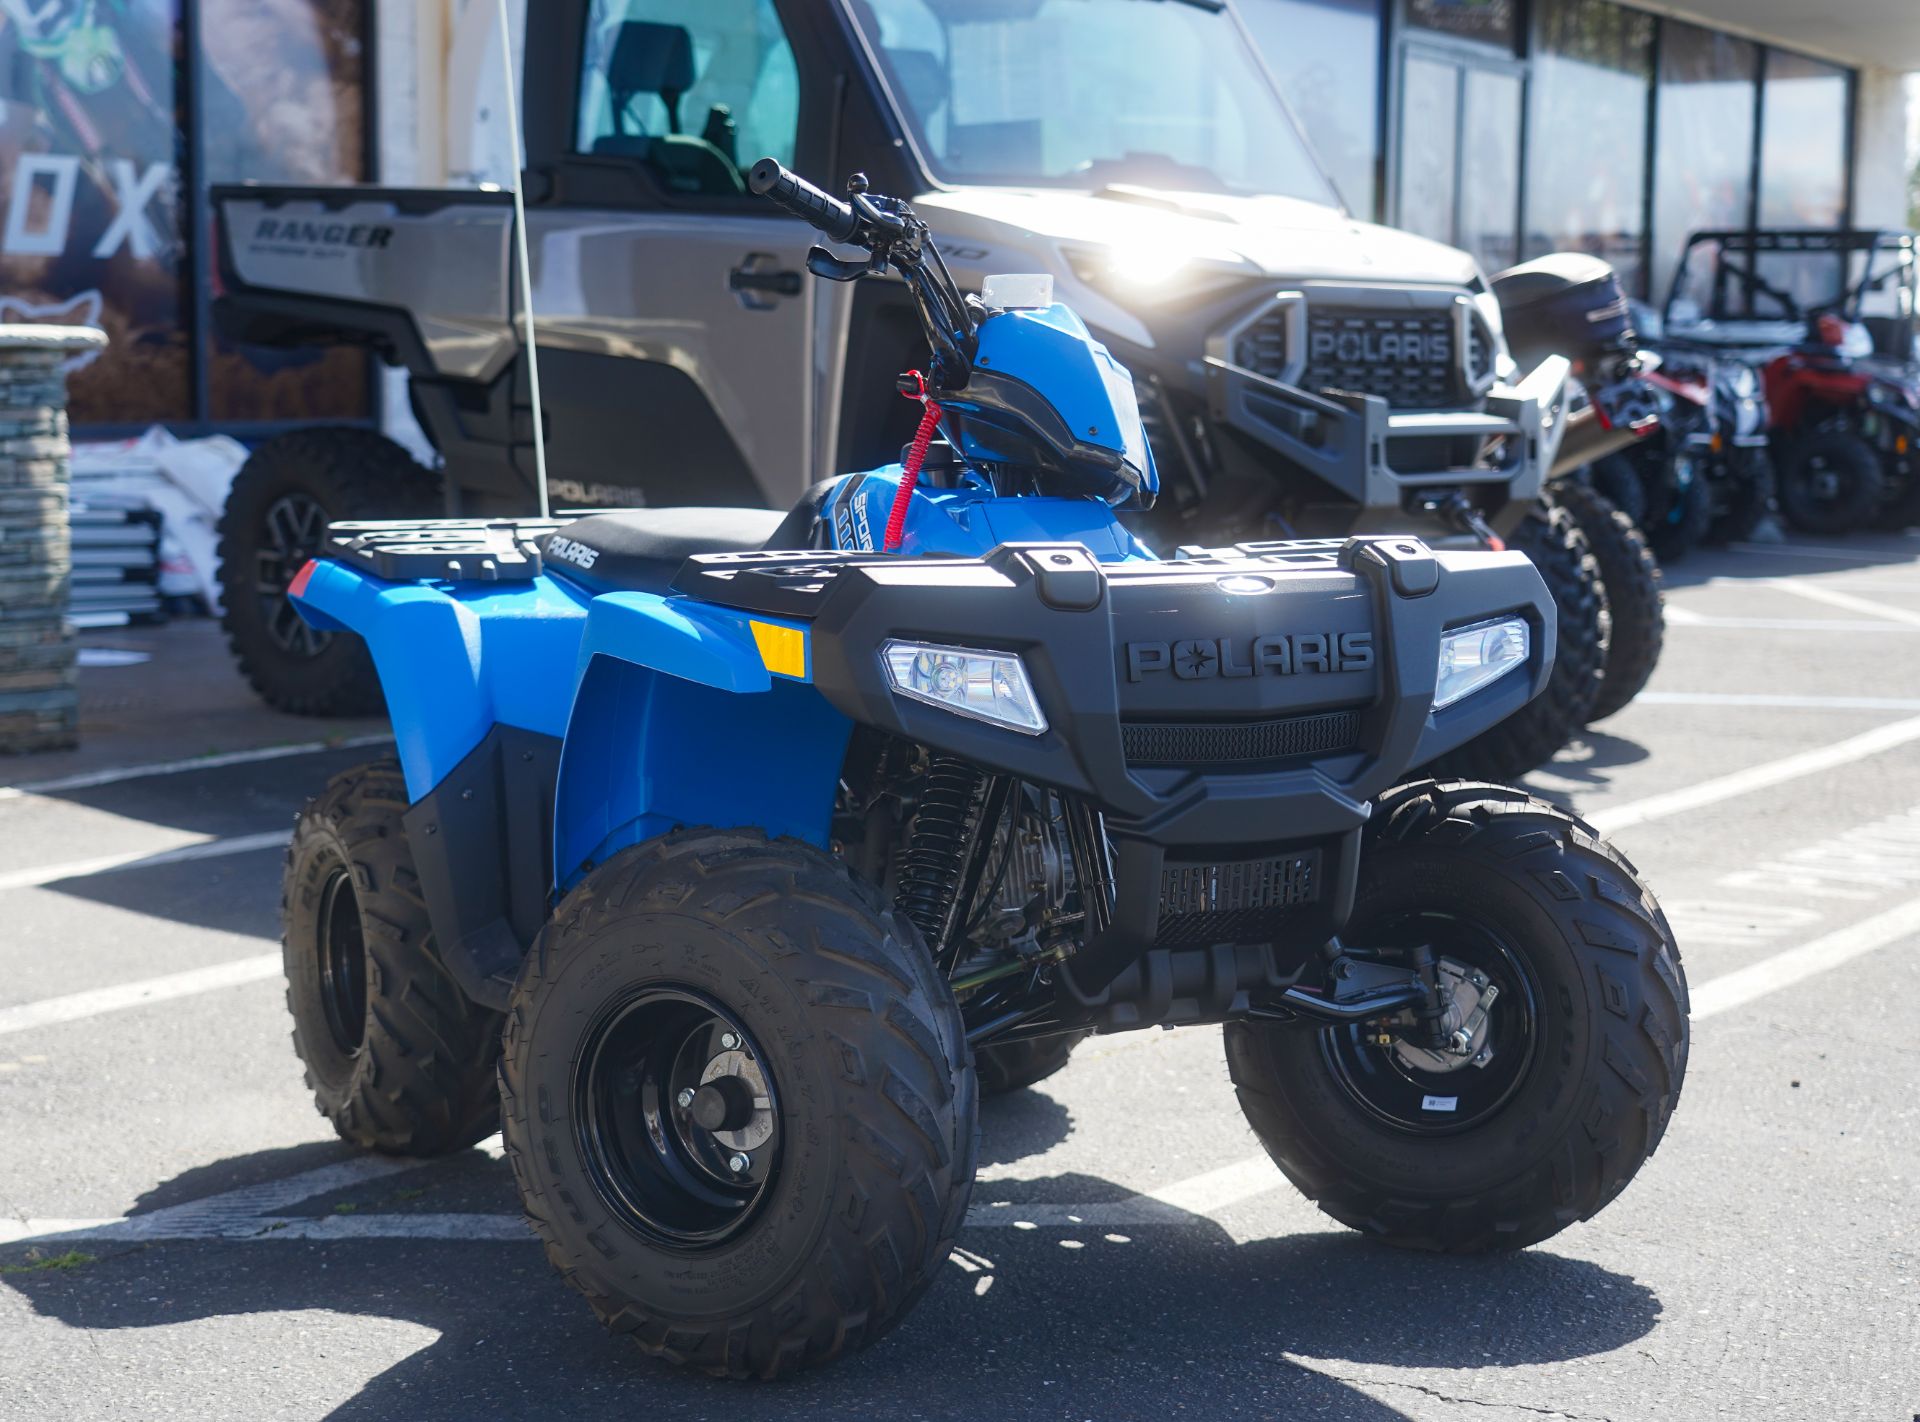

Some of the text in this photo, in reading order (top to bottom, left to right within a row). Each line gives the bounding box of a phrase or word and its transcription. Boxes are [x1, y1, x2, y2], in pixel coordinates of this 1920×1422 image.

[255, 217, 394, 250] RANGER
[1311, 331, 1450, 363] POLARIS
[547, 479, 645, 508] POLARIS
[854, 490, 875, 552] SPOR
[547, 535, 600, 570] POLARIS
[1125, 631, 1376, 684] POLARIS
